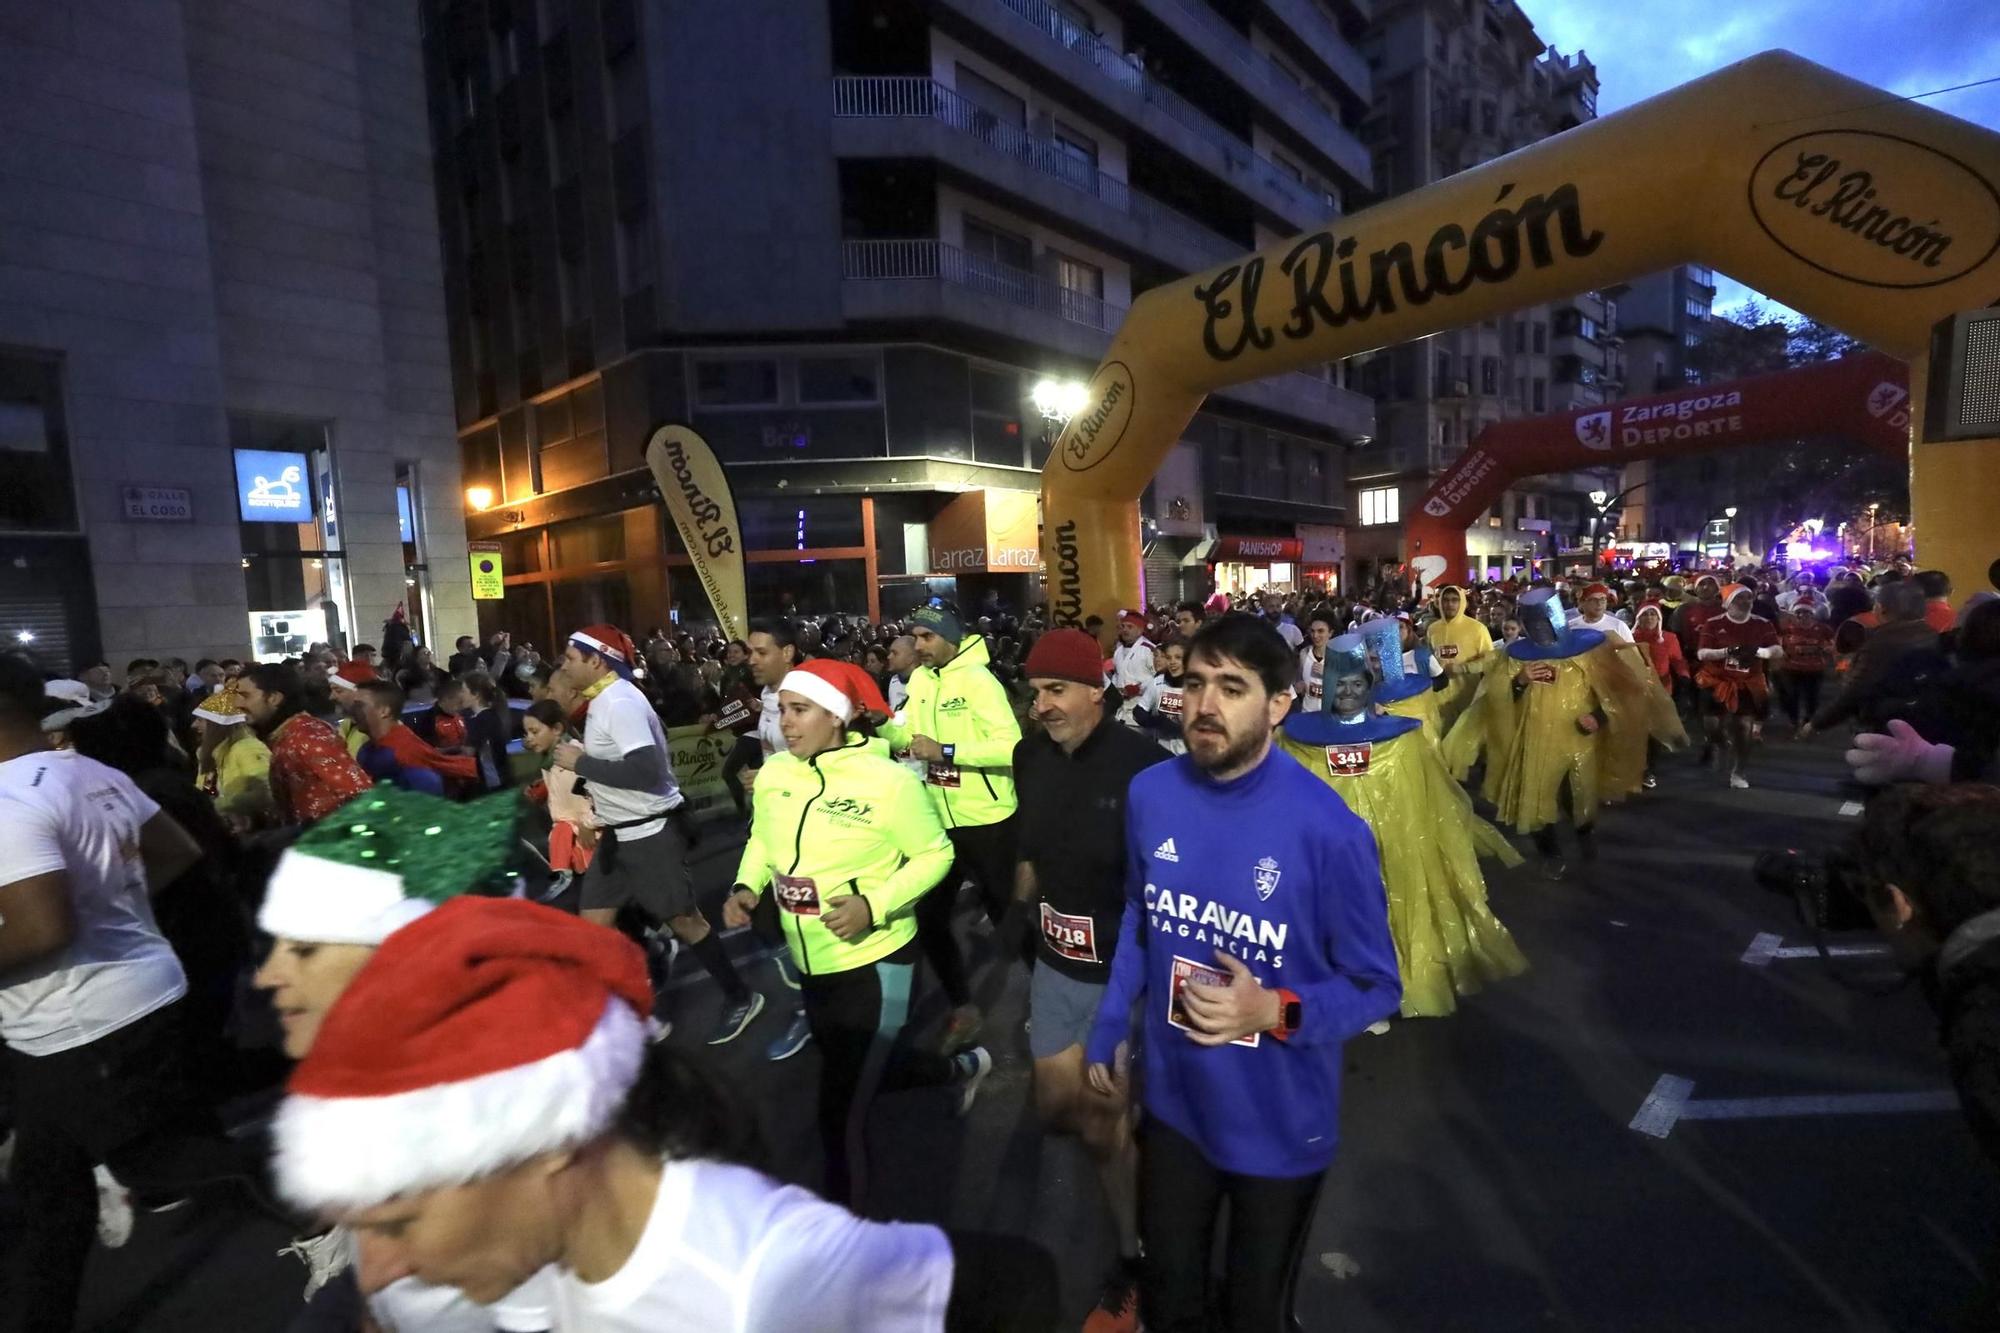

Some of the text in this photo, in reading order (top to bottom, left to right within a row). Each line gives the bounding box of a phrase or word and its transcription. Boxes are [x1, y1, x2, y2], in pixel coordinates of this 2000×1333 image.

[1774, 152, 1953, 267] El Rincón
[1194, 183, 1605, 362] El Rincón
[1067, 380, 1125, 460] El Rincón
[1622, 391, 1742, 421] Zaragoza
[1622, 415, 1743, 448] DEPORTE
[1440, 450, 1486, 497] Zaragoza
[1448, 457, 1497, 505] DEPORTE
[132, 504, 186, 516] EL COSO
[932, 547, 986, 569] Larraz
[989, 544, 1039, 567] Larraz
[1238, 540, 1283, 556] PANISHOP
[1052, 519, 1083, 630] Rincón
[1337, 752, 1364, 765] 341
[1153, 850, 1179, 863] adidas
[1046, 919, 1087, 946] 1718
[1144, 883, 1288, 951] CARAVAN
